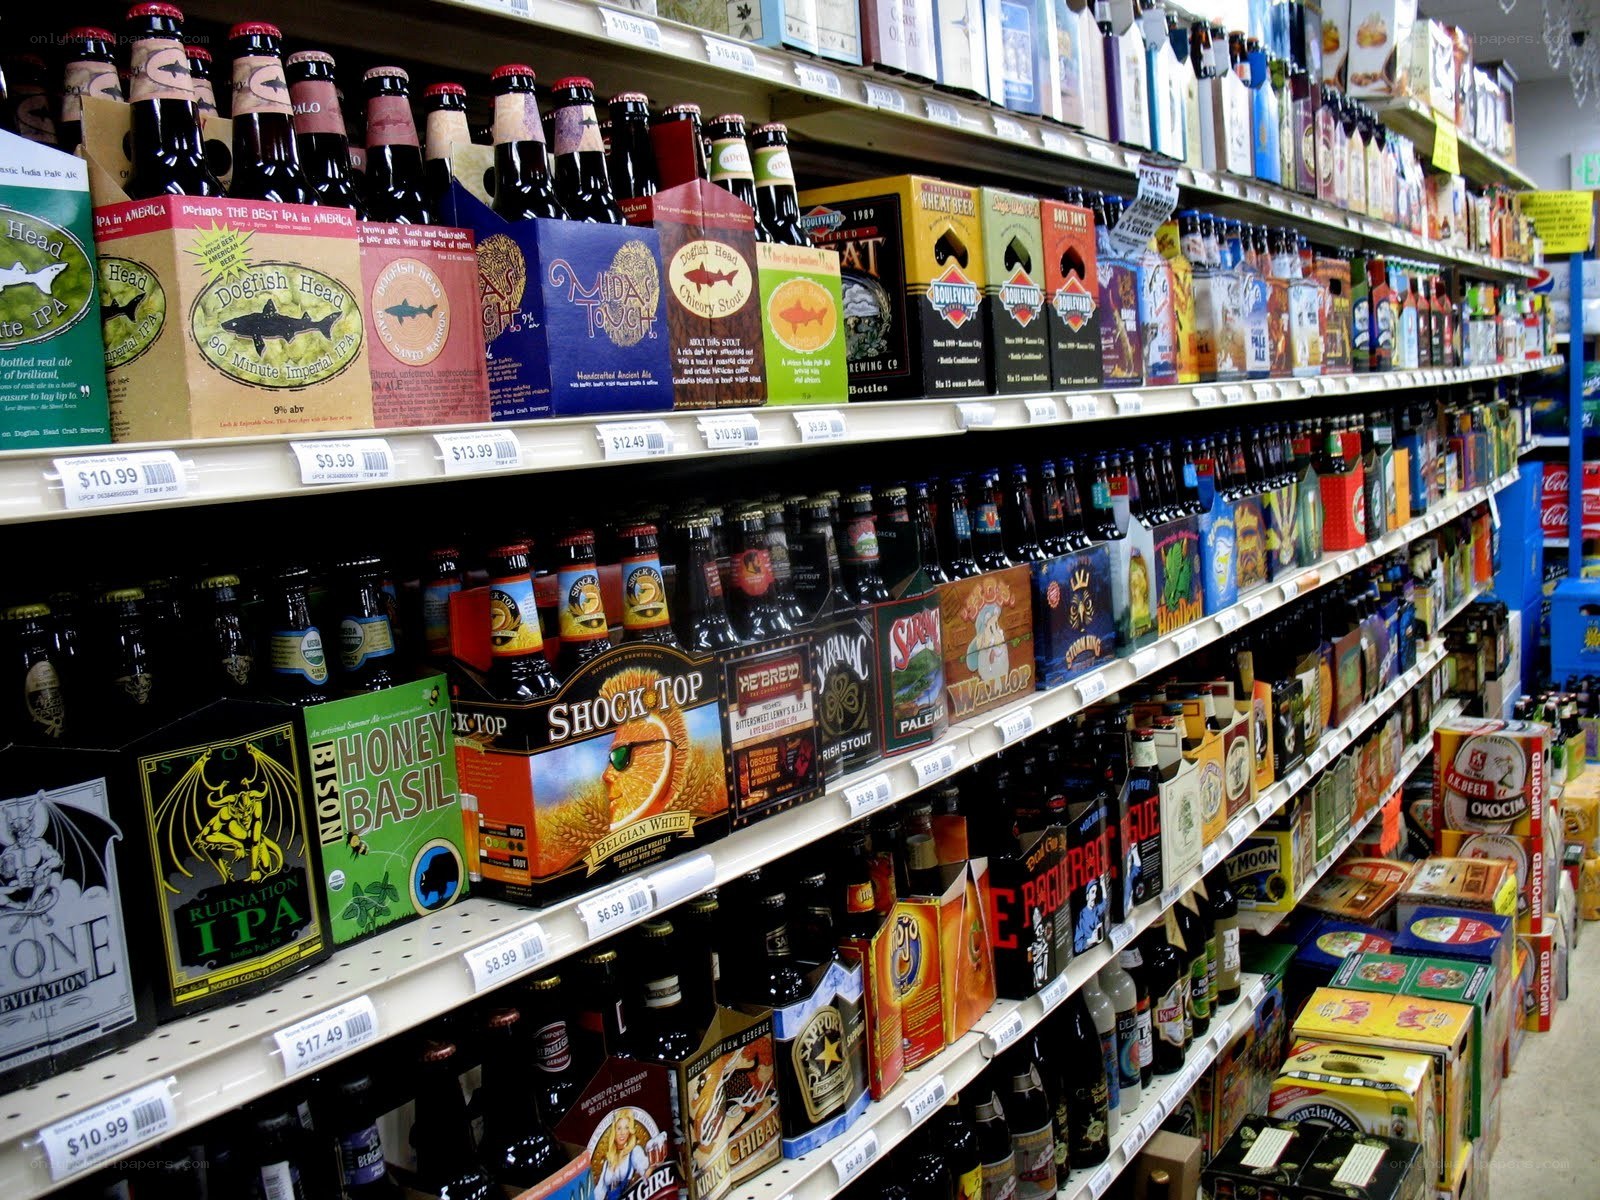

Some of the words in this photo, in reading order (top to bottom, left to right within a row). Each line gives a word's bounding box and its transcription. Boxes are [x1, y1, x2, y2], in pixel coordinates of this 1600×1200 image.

[612, 16, 641, 34] $10.99
[96, 215, 111, 228] IPA
[113, 213, 122, 225] in
[125, 204, 166, 222] AMERICA
[182, 205, 223, 217] perhaps
[226, 207, 248, 218] THE
[251, 209, 279, 221] BEST
[282, 209, 298, 222] IPA
[301, 212, 310, 224] in
[313, 213, 353, 227] AMERICA
[920, 192, 950, 213] WHEAT
[953, 198, 975, 217] BEER
[801, 213, 839, 228] BOULEVARD
[853, 208, 874, 221] 1989
[7, 219, 64, 259] Head
[202, 241, 221, 257] Voted
[221, 235, 236, 247] BEST
[208, 242, 239, 265] AMERICAN
[219, 254, 236, 267] BEER
[680, 242, 709, 266] Dogfish
[714, 243, 738, 266] Head
[109, 263, 148, 291] Head
[376, 261, 415, 297] DOGFISH
[419, 268, 441, 299] HEAD
[548, 258, 652, 307] MIDAS
[214, 271, 289, 309] Dogfish
[300, 274, 345, 310] Head
[679, 284, 715, 318] Chicory
[719, 289, 744, 313] Stout
[934, 285, 975, 305] BOULEVARD
[1005, 289, 1039, 304] BOULEVARD
[31, 297, 69, 331] IPA
[1058, 295, 1090, 312] BOULEVARD
[139, 312, 158, 339] IPA
[575, 298, 658, 339] TOUCH
[376, 310, 393, 344] PALO
[393, 345, 424, 361] SANTO
[689, 338, 705, 346] ABOUT
[722, 338, 740, 346] STOUT
[1, 357, 35, 367] bottled
[37, 357, 55, 367] real
[58, 357, 73, 367] ale
[208, 335, 227, 357] 90
[232, 352, 279, 379] Minute
[286, 356, 333, 380] Imperial
[335, 334, 355, 358] IPA
[4, 370, 15, 380] of
[385, 380, 404, 392] ALE
[577, 370, 616, 380] Handcrafted
[617, 369, 641, 379] Ancient
[642, 369, 651, 379] Ale
[849, 384, 888, 394] Bottles
[273, 405, 287, 415] 9%
[289, 405, 305, 414] abv
[15, 429, 40, 438] Dogfish
[715, 428, 742, 441] $10.99
[809, 421, 827, 433] $9.99
[452, 443, 493, 461] $13.99
[613, 435, 645, 449] $12.49
[316, 452, 355, 470] $9.99
[78, 467, 138, 490] $10.99
[571, 576, 593, 598] SHOCK
[628, 568, 649, 588] SHOCK
[650, 569, 662, 584] TOP
[501, 594, 516, 611] TOP
[1086, 634, 1102, 657] KING
[947, 664, 1032, 717] WALLOP
[549, 686, 648, 743] SHOCK
[654, 672, 703, 710] TOP
[473, 713, 507, 736] TOP
[761, 723, 774, 733] BASED
[900, 715, 932, 734] PALE
[931, 707, 944, 725] ALE
[337, 708, 448, 787] HONEY
[841, 732, 872, 752] STOUT
[749, 755, 778, 767] OBSCENE
[751, 763, 777, 777] AMOUNT
[923, 761, 939, 776] $8.99
[311, 739, 344, 846] BISON
[1462, 781, 1488, 797] BEER
[1531, 752, 1541, 820] IMPORTED
[343, 762, 457, 839] BASIL
[857, 790, 874, 806] $8.99
[1471, 797, 1526, 818] OKOCIM
[509, 827, 524, 838] HOPS
[596, 823, 647, 858] BELGIAN
[650, 815, 686, 832] WHITE
[613, 843, 648, 864] BELGIAN-STYLE
[648, 840, 663, 850] WHEAT
[663, 835, 672, 845] ALE
[618, 856, 638, 868] BREWED
[638, 850, 650, 860] WITH
[650, 845, 667, 856] SPICES
[1026, 842, 1045, 873] Dead
[512, 858, 526, 869] BODY
[1021, 853, 1070, 928] ROGUE
[1531, 851, 1541, 919] IMPORTED
[189, 875, 298, 922] RUINATION
[597, 901, 625, 924] $6.99
[194, 895, 303, 957] IPA
[210, 976, 239, 990] NORTH
[240, 968, 270, 982] COUNTY
[280, 954, 300, 968] DIEGO
[486, 949, 517, 974] $8.99
[1, 970, 88, 1014] EVITATION
[1539, 950, 1550, 1017] IMPORTED
[28, 1005, 58, 1023] ALE
[296, 1026, 343, 1058] $17.49
[688, 1055, 710, 1079] SPECIAL
[742, 1021, 770, 1044] RESERVE
[546, 1055, 569, 1066] GERMANY
[581, 1090, 606, 1111] IMPORTED
[606, 1083, 623, 1096] FROM
[623, 1070, 648, 1088] GERMANY
[68, 1117, 129, 1157] $10.99
[723, 1115, 780, 1173] ICHIBAN
[634, 1166, 675, 1200] GIRL
[696, 1162, 723, 1198] KIRIN
